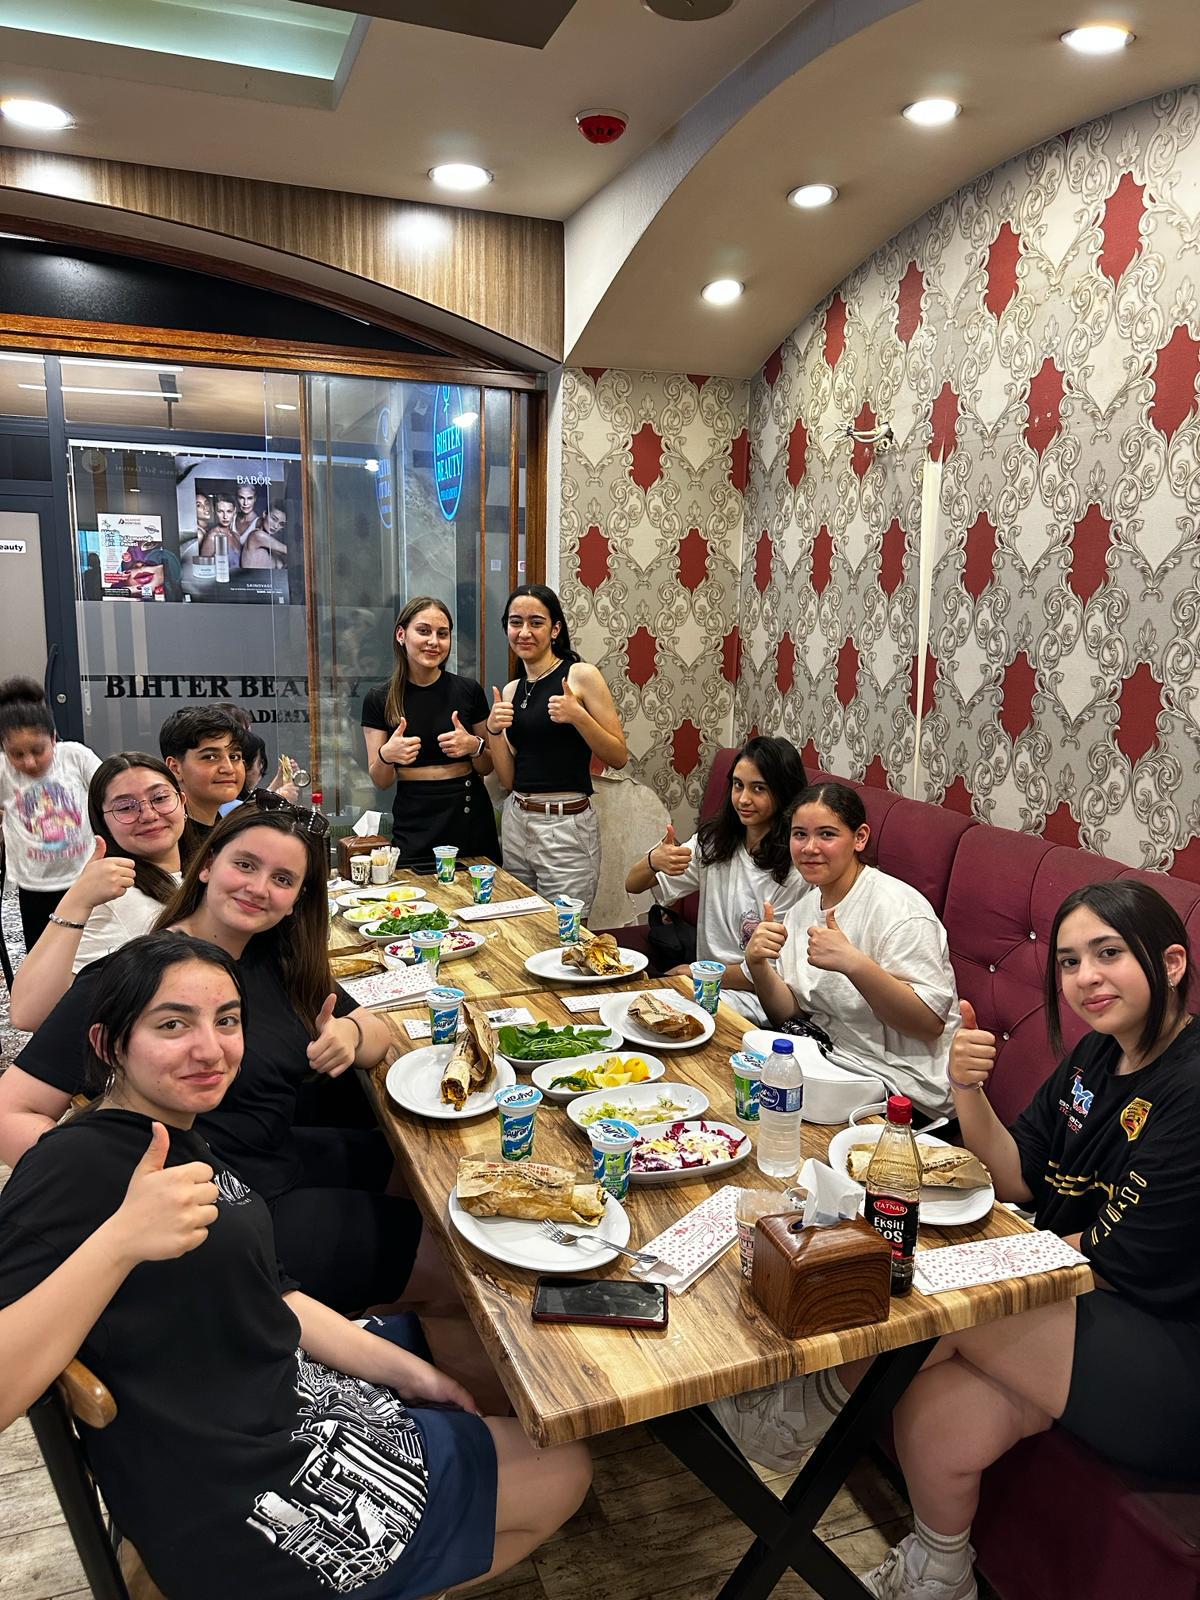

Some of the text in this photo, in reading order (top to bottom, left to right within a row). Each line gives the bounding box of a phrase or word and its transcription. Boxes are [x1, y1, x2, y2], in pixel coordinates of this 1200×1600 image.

[436, 424, 461, 456] BIHTER
[436, 452, 461, 482] BEAUTY
[104, 675, 232, 698] BIHTER
[504, 1090, 534, 1104] Ayran
[506, 1126, 529, 1138] Ayran
[876, 1201, 905, 1213] TATNAR
